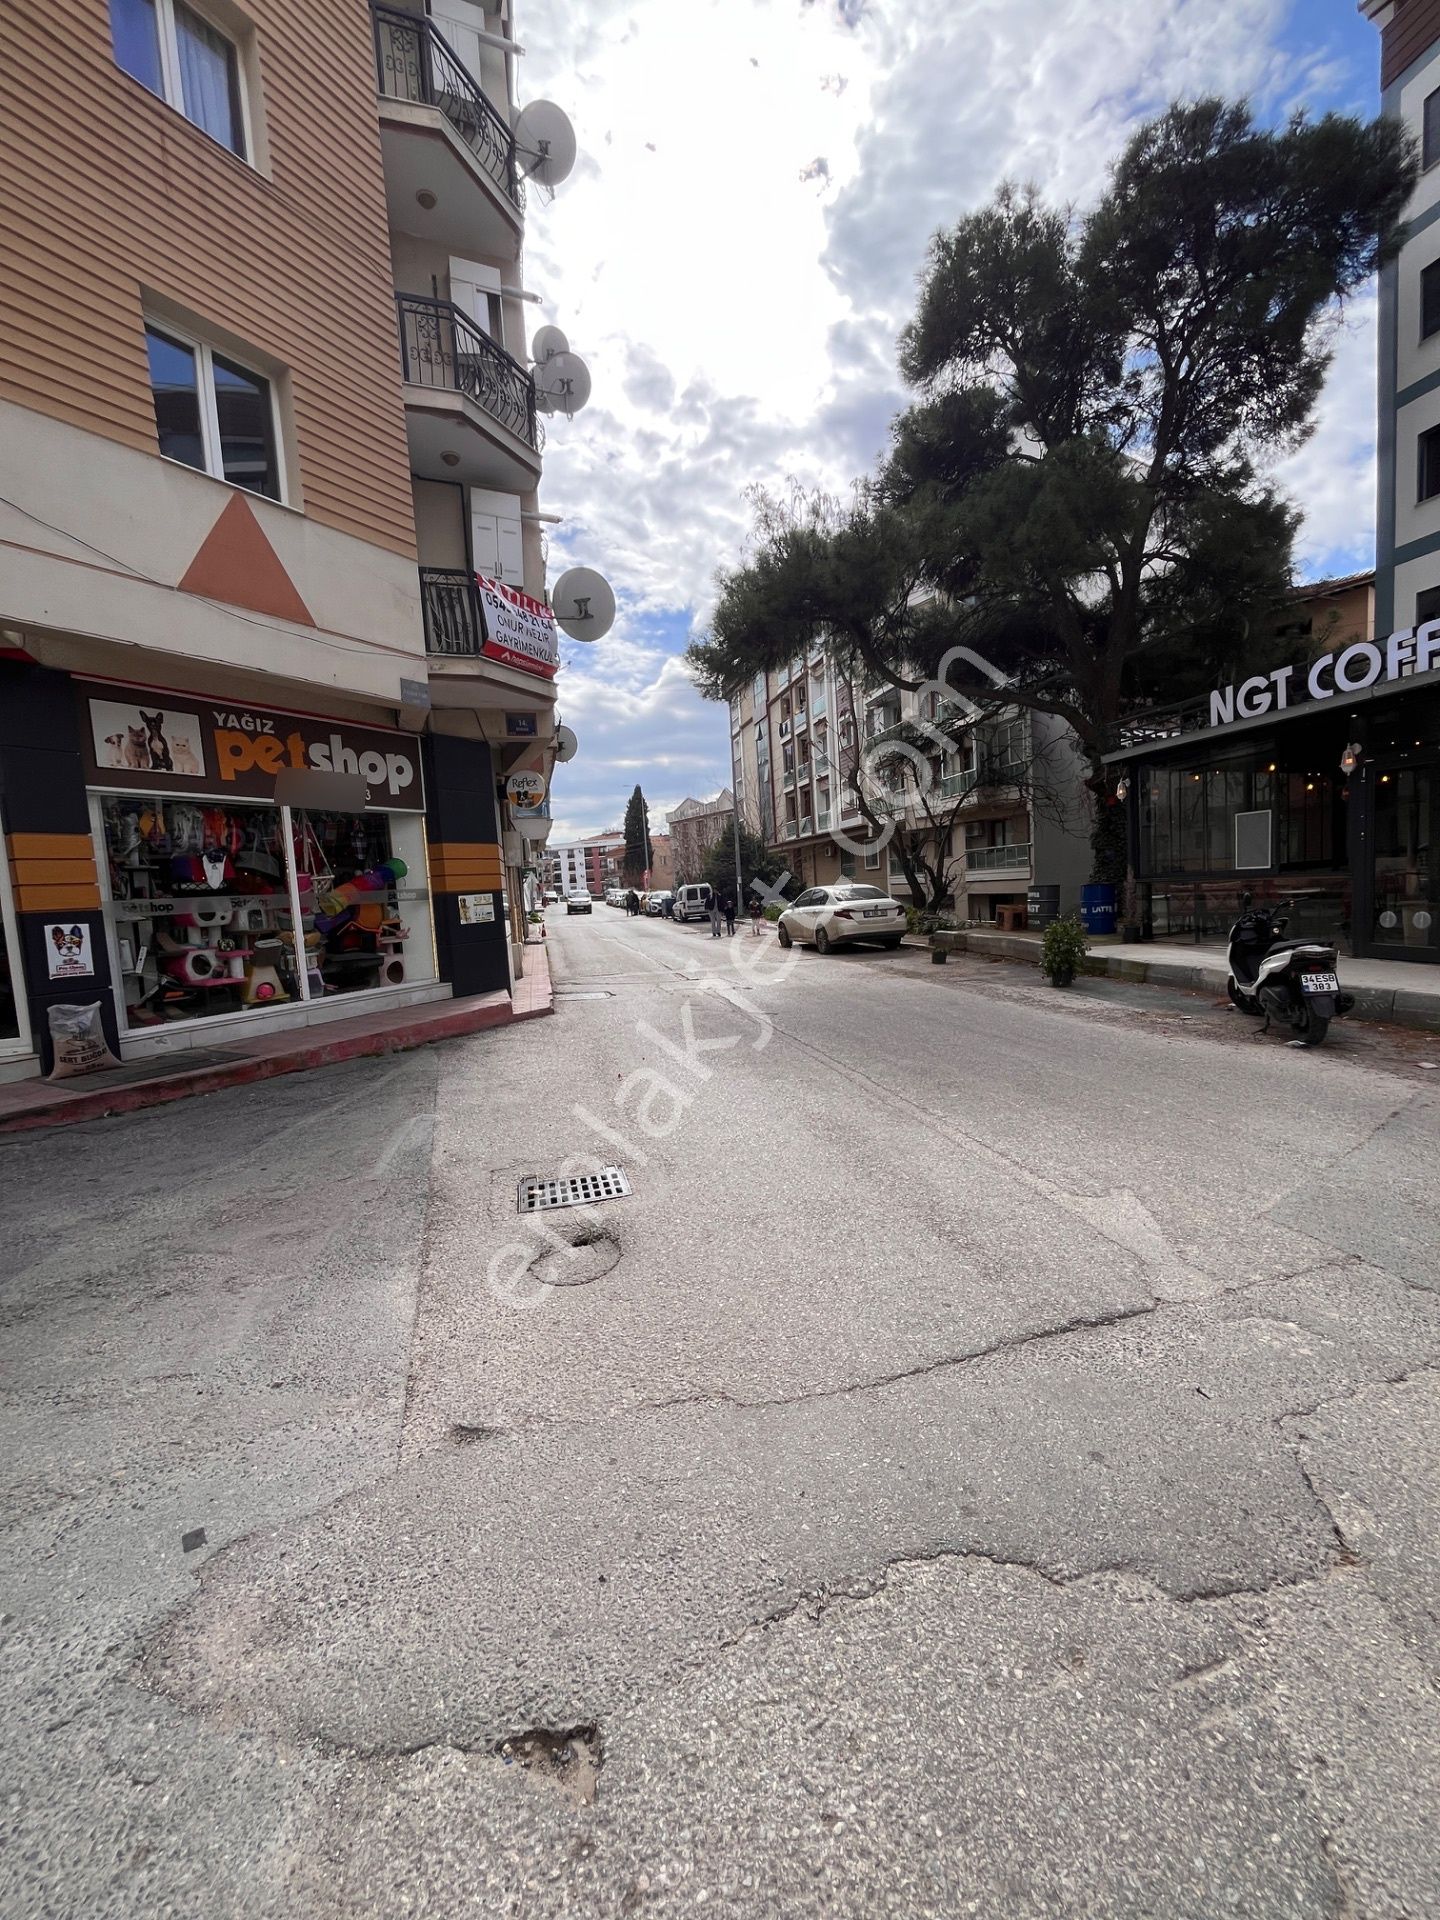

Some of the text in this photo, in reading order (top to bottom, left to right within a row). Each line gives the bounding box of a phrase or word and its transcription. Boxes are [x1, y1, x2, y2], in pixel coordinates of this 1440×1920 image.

[485, 592, 511, 614] 054
[497, 614, 524, 635] ONUR
[495, 630, 554, 663] GAYRİMENKUL
[1209, 665, 1293, 728] NGT
[212, 711, 275, 734] YAĞIZ
[512, 777, 538, 790] Reflex
